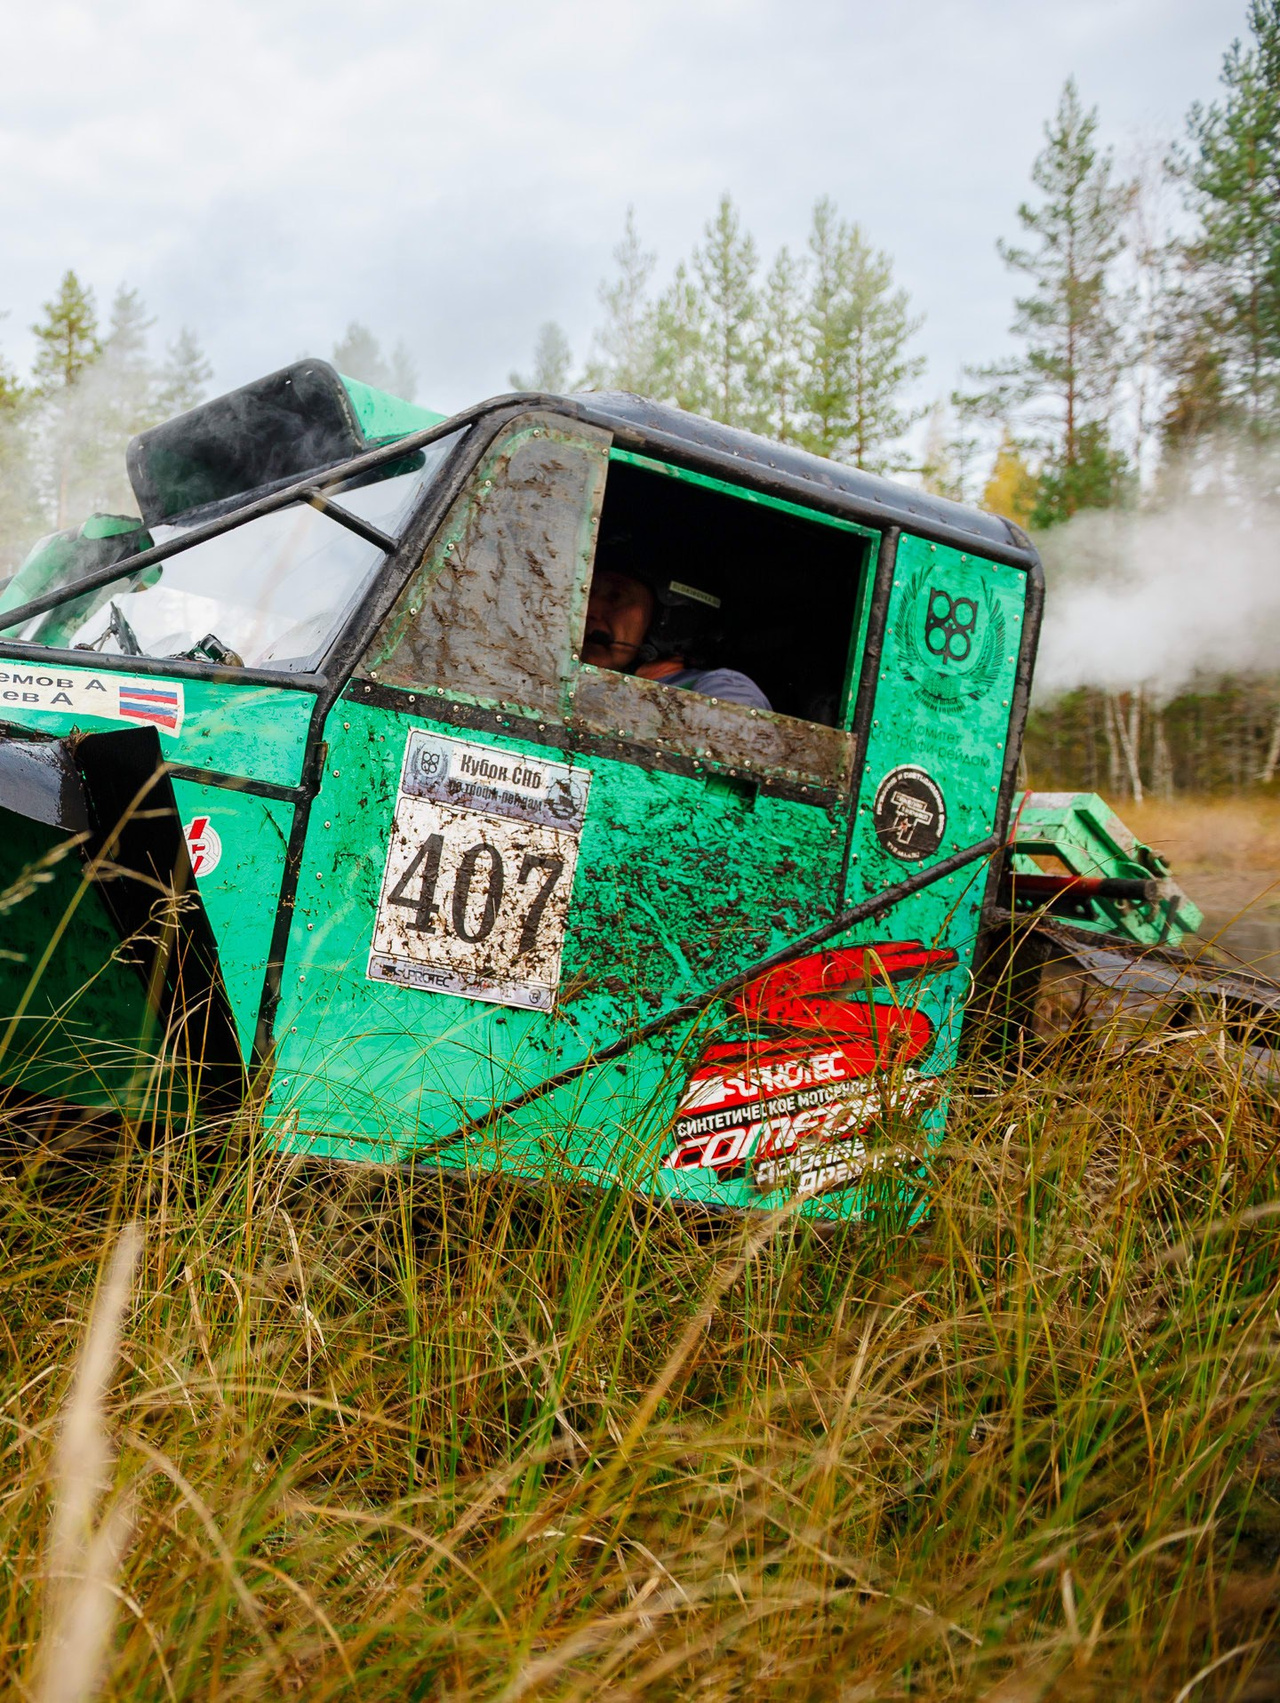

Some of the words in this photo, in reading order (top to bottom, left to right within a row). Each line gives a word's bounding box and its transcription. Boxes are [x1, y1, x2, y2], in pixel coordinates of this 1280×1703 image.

[460, 754, 509, 782] Кубок
[511, 766, 542, 789] СПб
[386, 832, 564, 957] 407
[396, 967, 451, 988] SUPROTEC
[677, 1098, 796, 1137] СИНТЕТИЧЕСКОЕ
